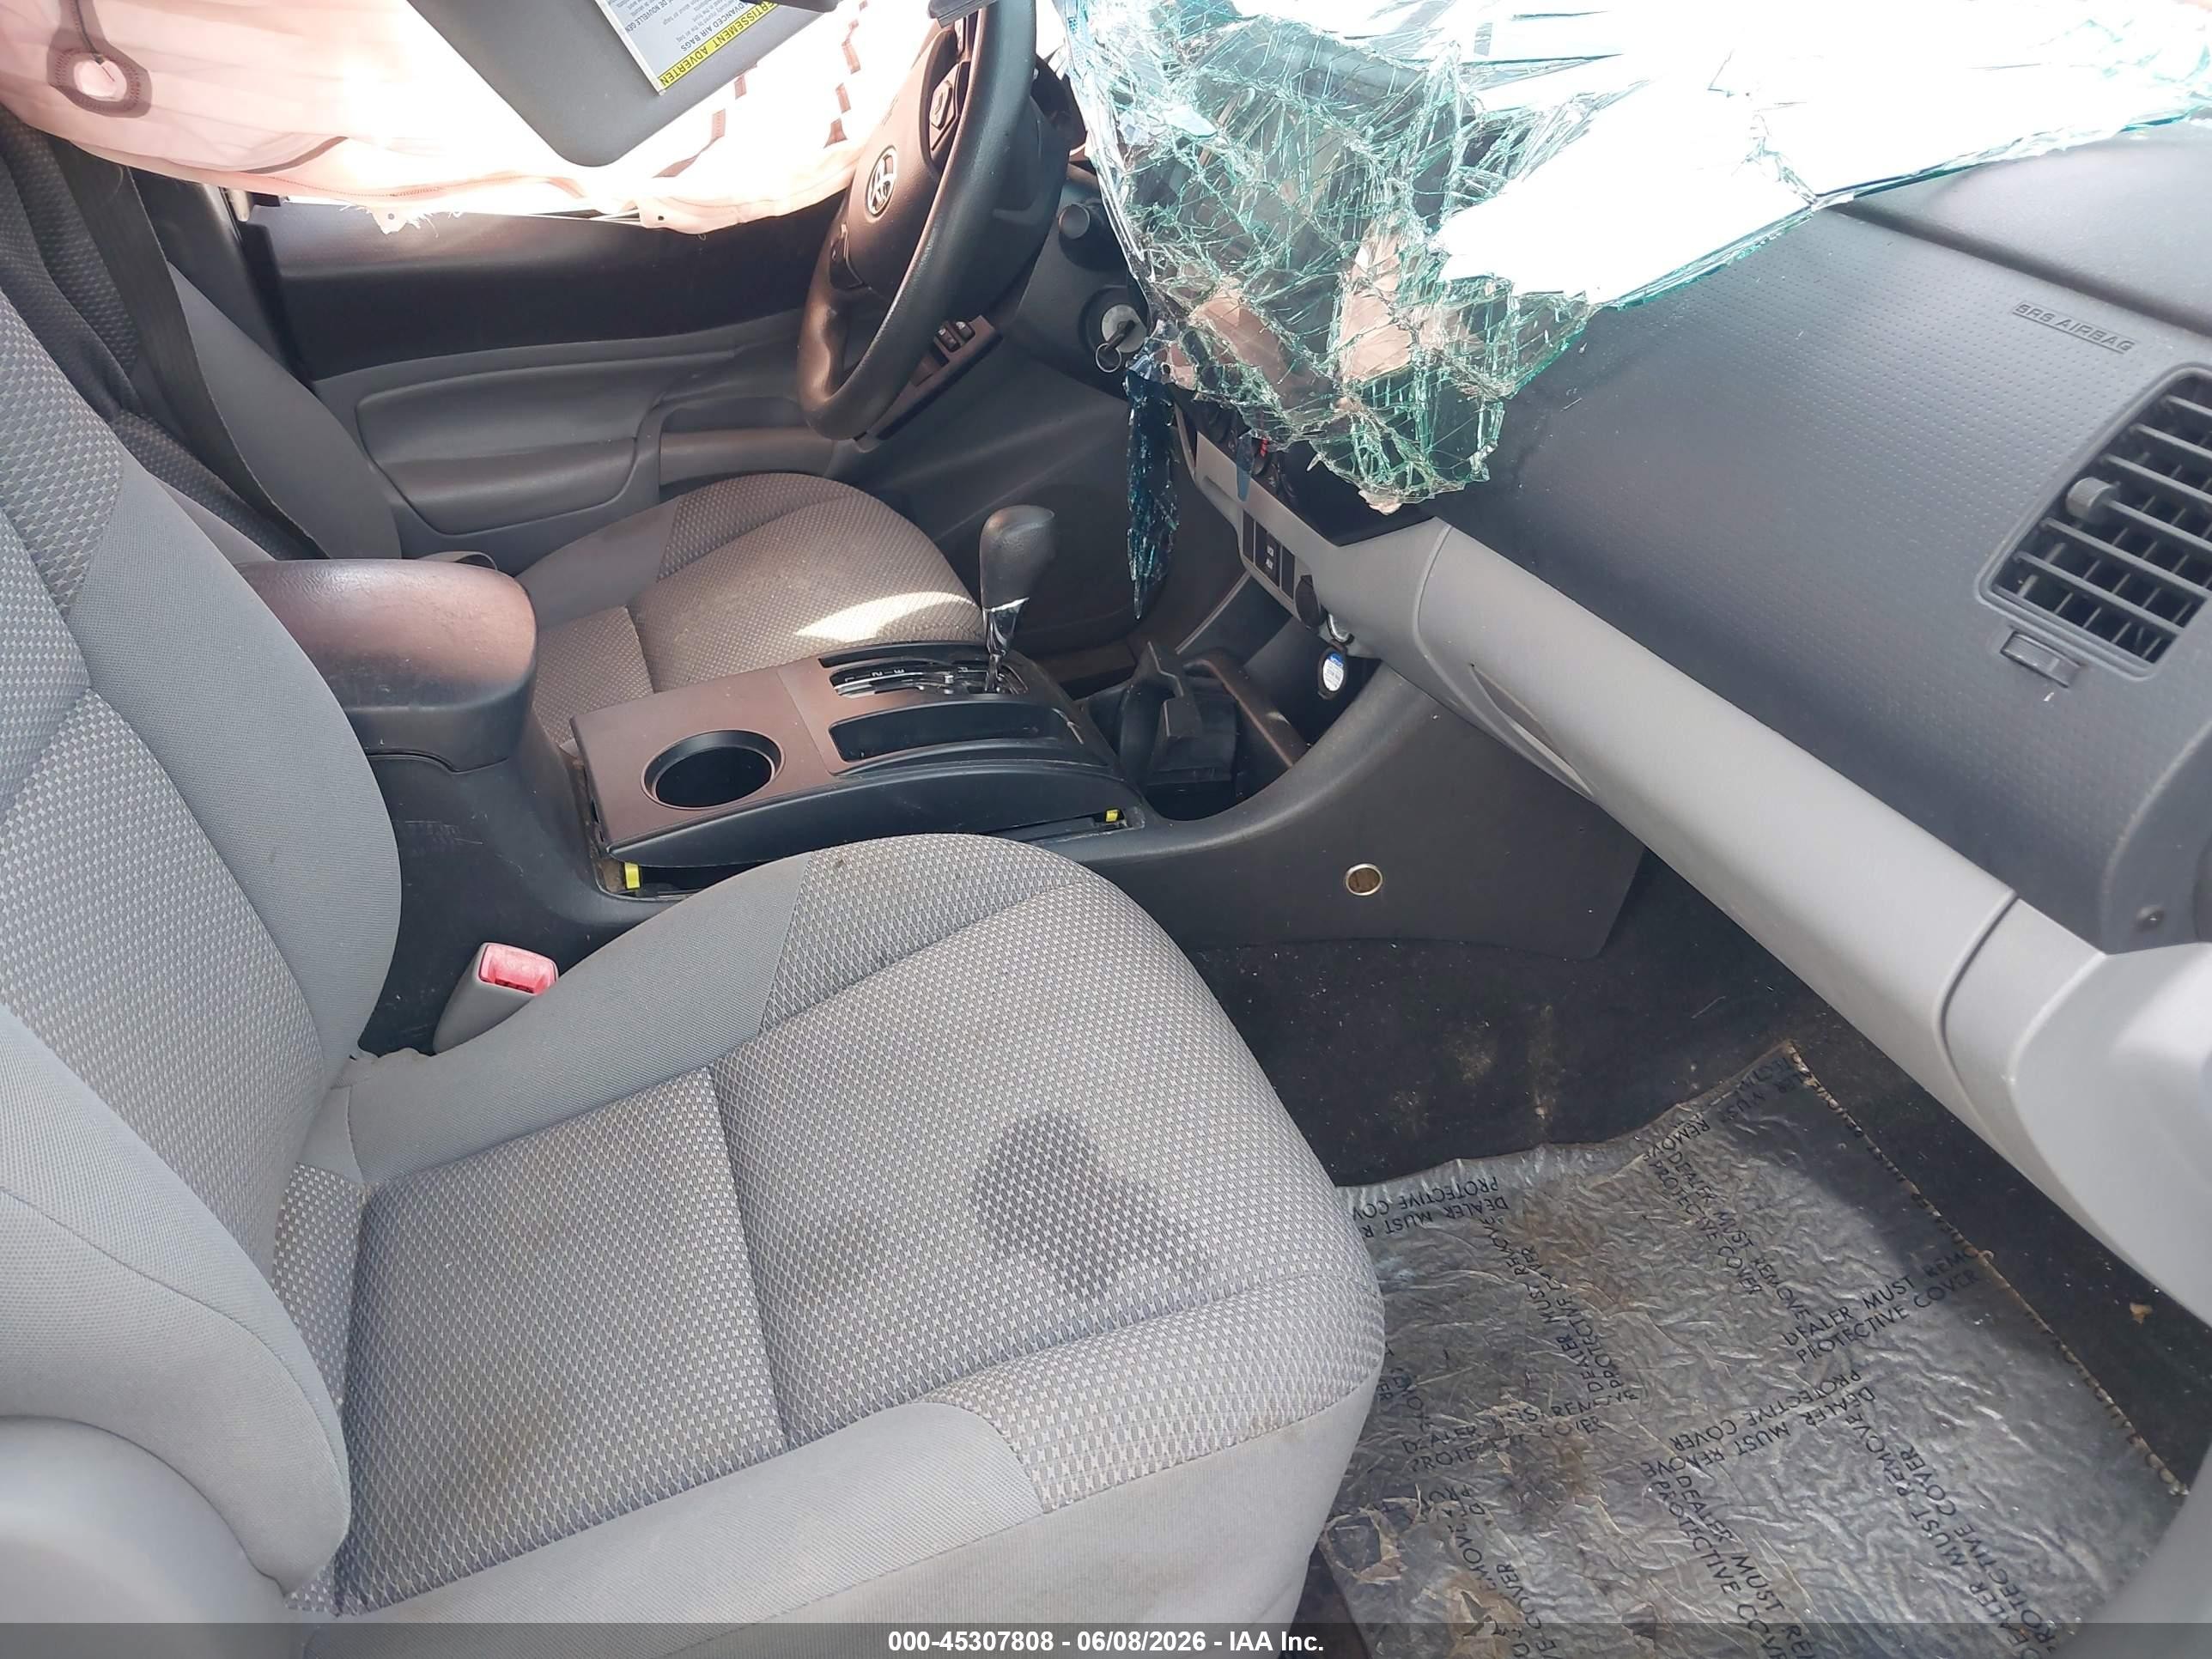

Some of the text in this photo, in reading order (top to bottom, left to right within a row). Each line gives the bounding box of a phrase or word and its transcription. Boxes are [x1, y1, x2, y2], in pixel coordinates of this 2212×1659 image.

[680, 34, 701, 52] BAGS
[701, 25, 714, 37] AIR
[2014, 302, 2136, 352] SRS AIRBAG
[1398, 1176, 1499, 1211] PROTECTIVE
[1444, 1194, 1510, 1219] DEALER
[1384, 1211, 1433, 1235] MUST
[1714, 1211, 1754, 1249] MUST
[1717, 1245, 1764, 1296] COVER
[1782, 1306, 1855, 1347] DEALER
[1861, 1273, 1916, 1310] MUST
[1795, 1267, 1980, 1364] PROTECTIVE COVER
[1641, 1385, 1876, 1479] DEALER MUST REMOVE
[1668, 1369, 1863, 1452] PROTECTIVE COVER
[1899, 1444, 1957, 1517] COVER
[1651, 1480, 1742, 1595] PROTECTIVE
[1676, 1474, 1786, 1612] DEALER MUST
[1910, 1508, 1969, 1568] MUST
